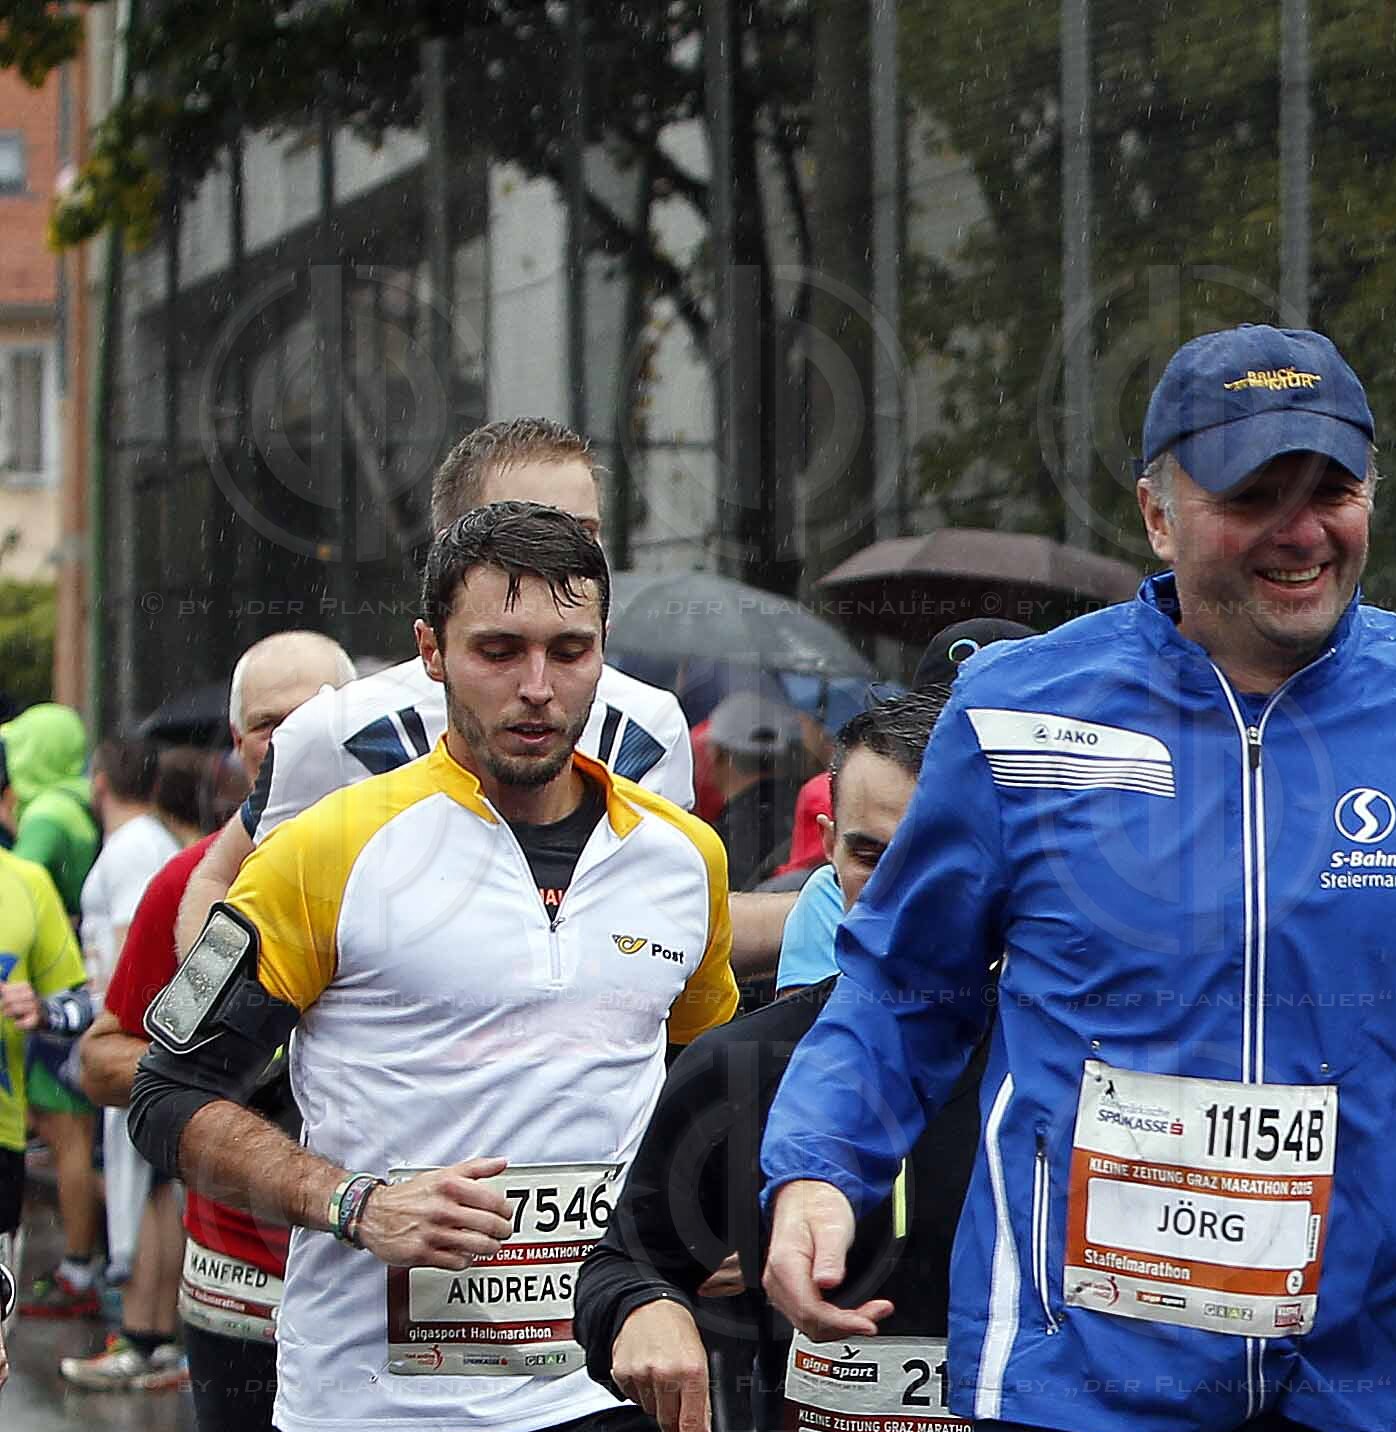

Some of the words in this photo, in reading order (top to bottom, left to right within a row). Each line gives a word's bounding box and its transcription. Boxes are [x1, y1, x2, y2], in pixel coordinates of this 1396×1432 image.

[1053, 728, 1099, 746] JAKO
[651, 943, 684, 964] Post
[1205, 1104, 1325, 1162] 11154B
[1089, 1158, 1129, 1177] KLEINE
[1132, 1164, 1184, 1185] ZEITUNG
[1187, 1173, 1217, 1190] GRAZ
[1220, 1177, 1289, 1196] MARATHON
[1290, 1180, 1314, 1196] 2015
[1157, 1200, 1246, 1243] JÖRG
[497, 1247, 524, 1262] GRAZ
[526, 1245, 580, 1261] MARATHON
[1084, 1248, 1191, 1281] Staffelmarathon
[447, 1273, 573, 1304] ANDREAS
[408, 1326, 467, 1342] gigasport
[470, 1325, 552, 1341] Halbmarathon
[802, 1356, 830, 1373] giga
[832, 1365, 875, 1379] sport
[799, 1409, 831, 1428] KLEINE
[833, 1417, 881, 1432] ZEITUNG
